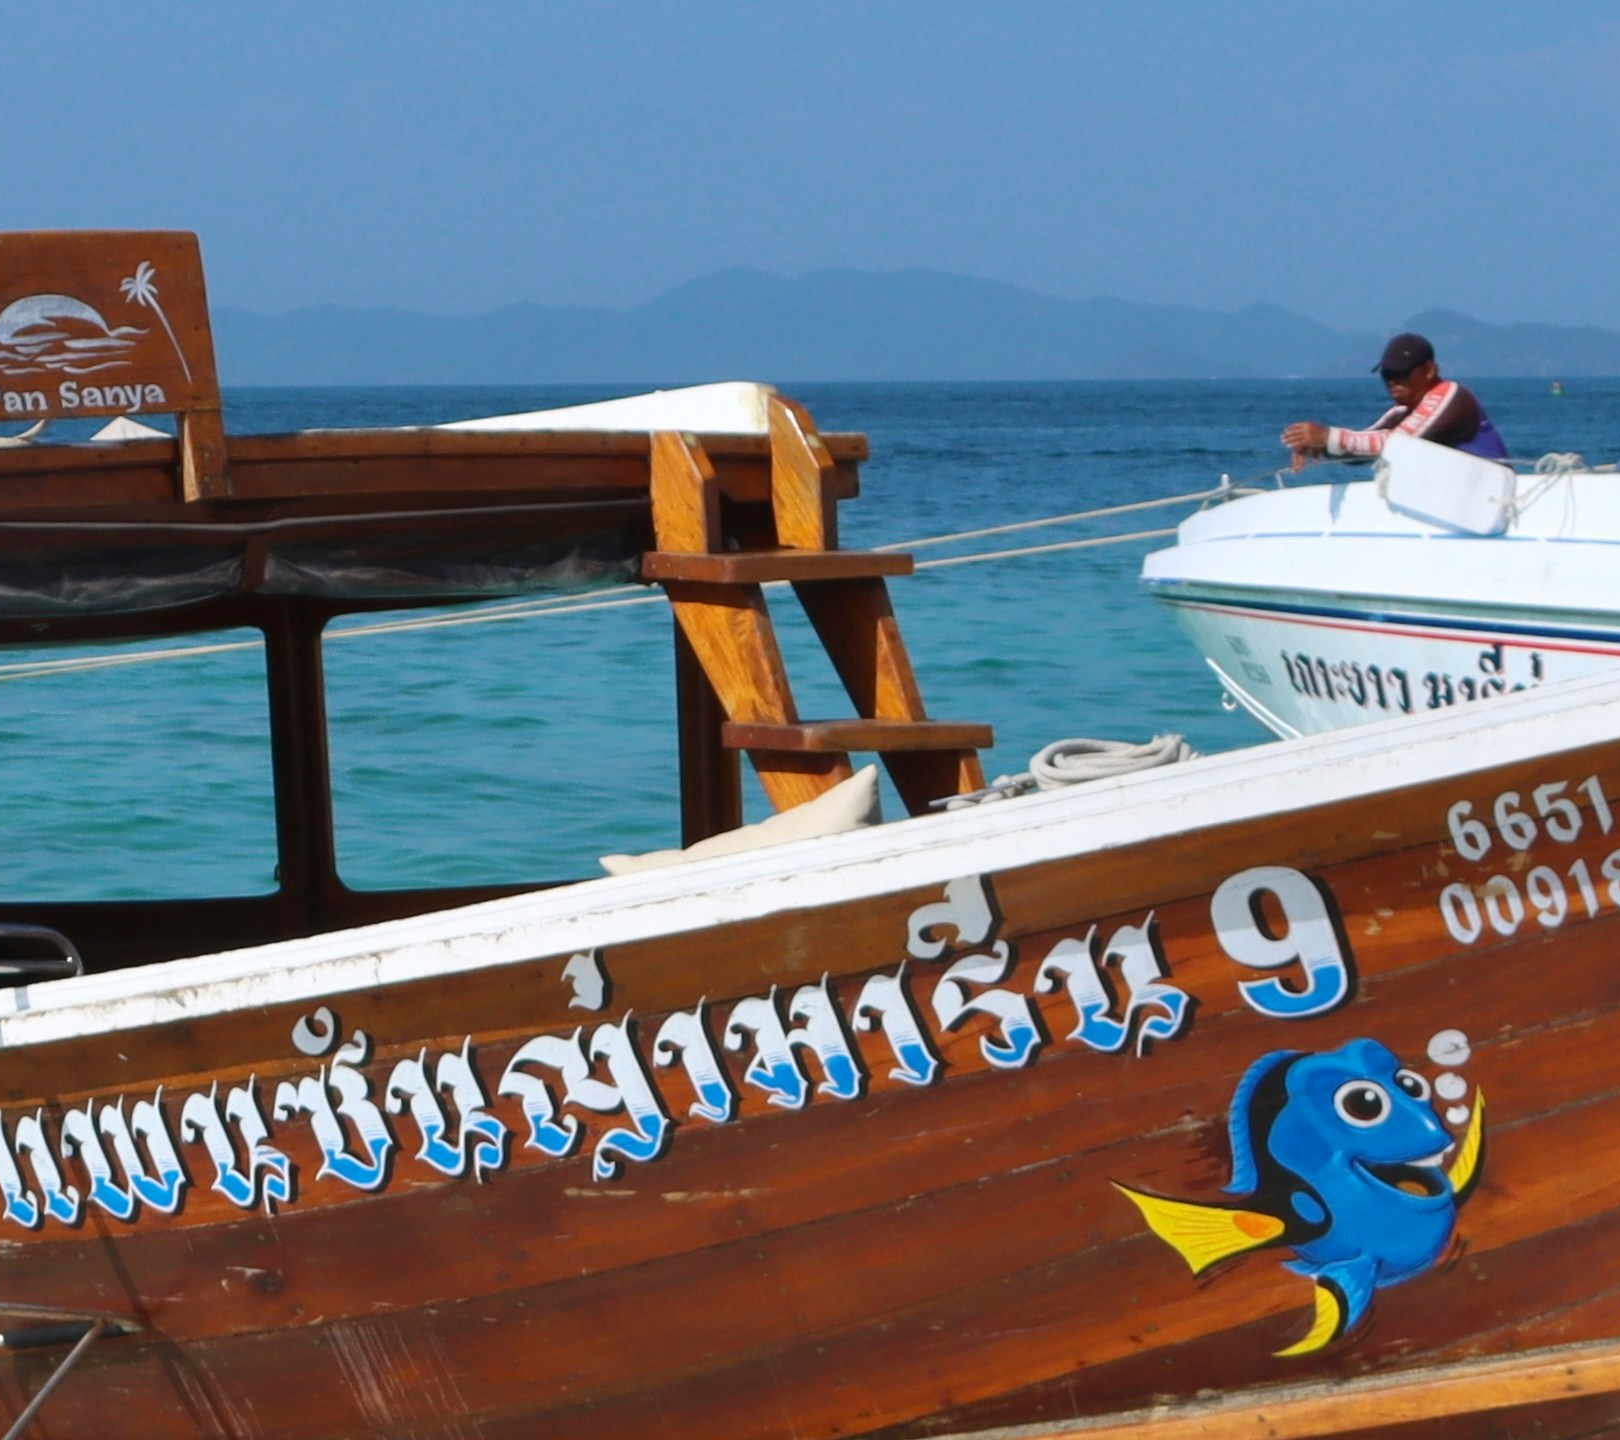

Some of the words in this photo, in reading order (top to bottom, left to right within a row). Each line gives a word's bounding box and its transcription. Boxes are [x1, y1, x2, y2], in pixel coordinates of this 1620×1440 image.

[59, 381, 166, 414] Sanya
[1281, 648, 1416, 715] เกาะยาว
[1447, 775, 1616, 861] 6651
[1210, 865, 1350, 1018] 9
